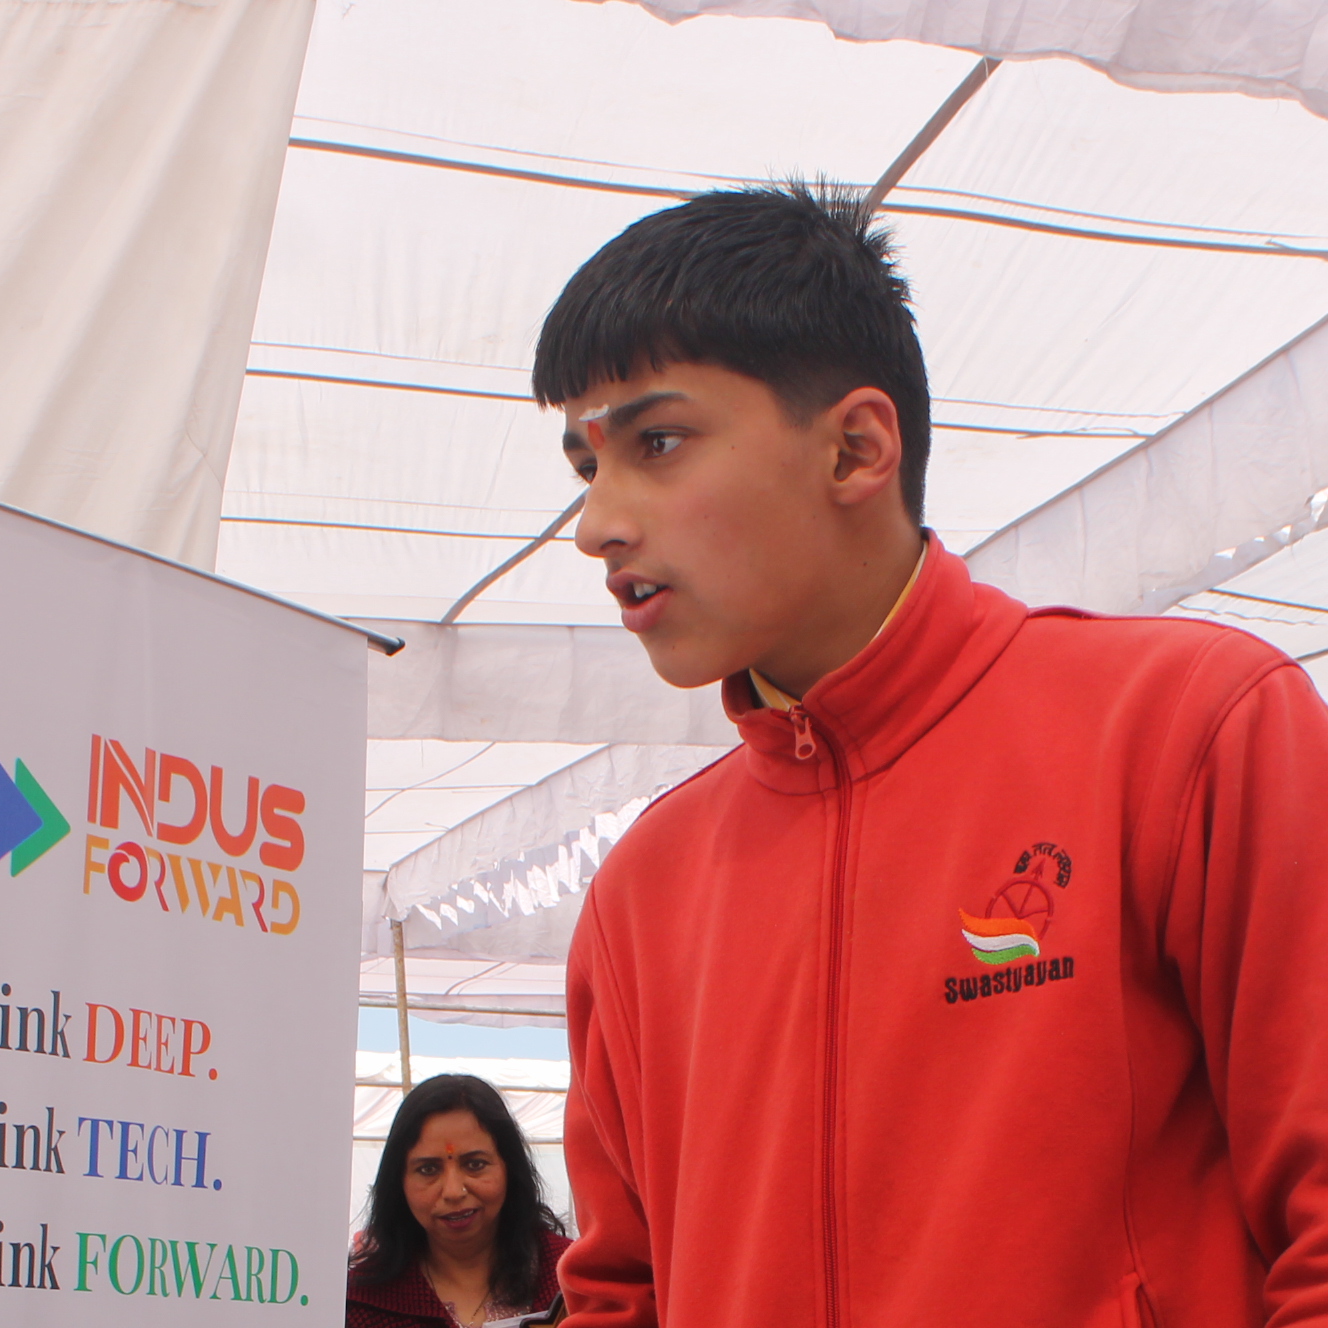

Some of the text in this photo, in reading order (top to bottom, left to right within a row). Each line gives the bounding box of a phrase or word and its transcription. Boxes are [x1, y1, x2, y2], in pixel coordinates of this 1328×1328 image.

[86, 733, 306, 872] INDUS
[83, 833, 301, 936] FORWARD
[945, 956, 1075, 1004] Swastyayan
[82, 1002, 219, 1081] DEEP.
[78, 1116, 223, 1191] TECH.
[73, 1231, 309, 1307] FORWARD.
